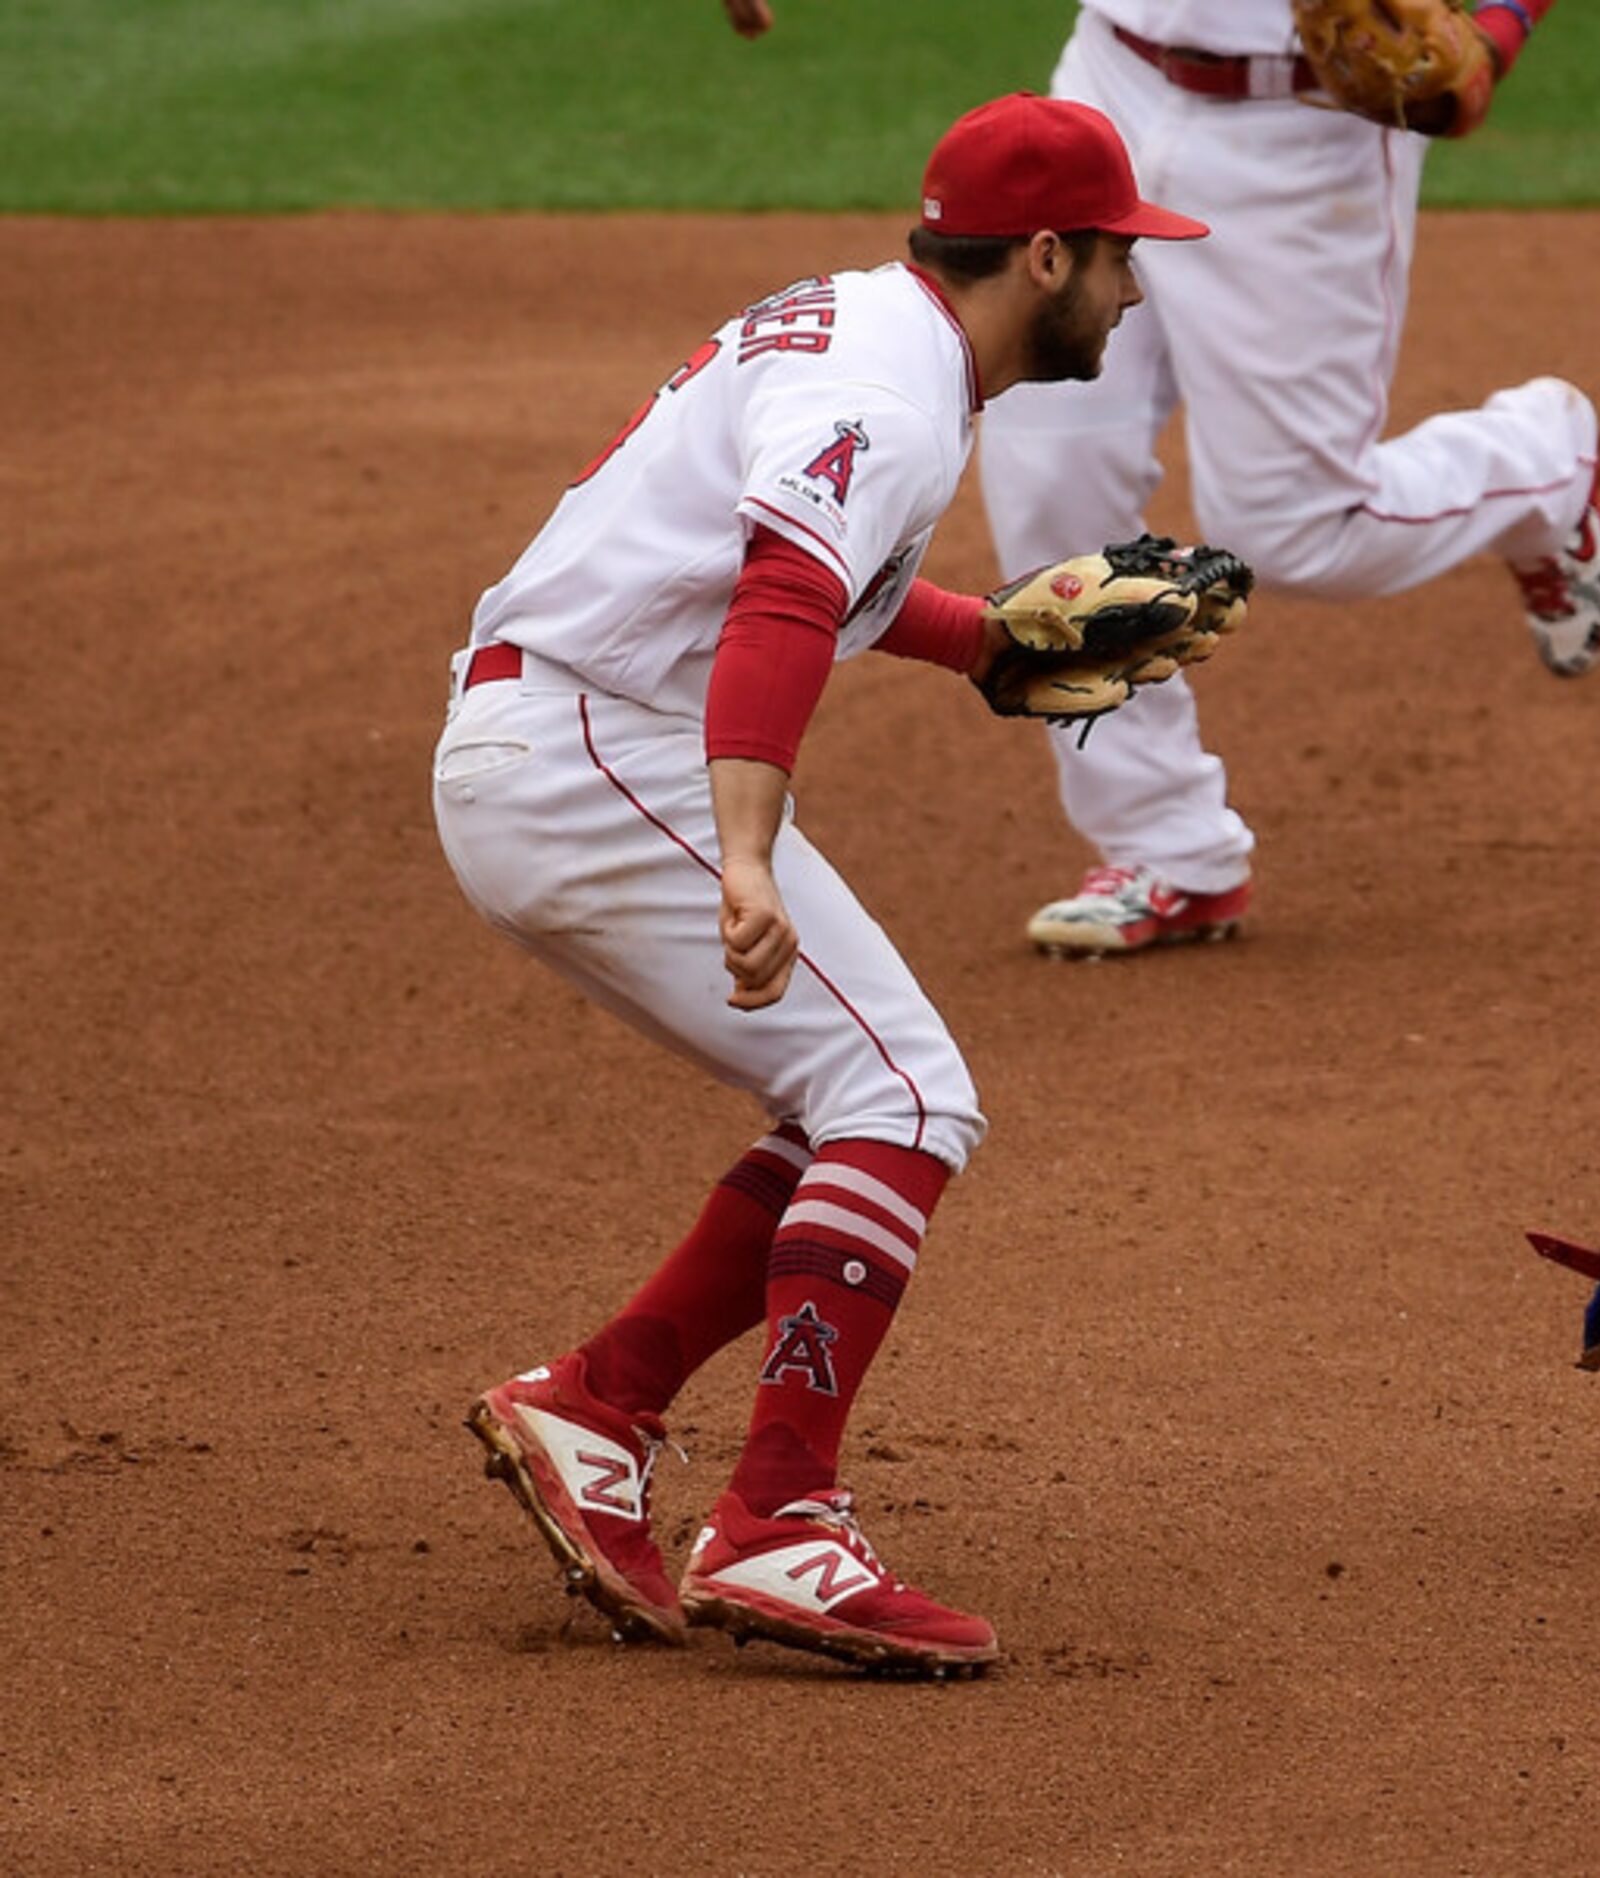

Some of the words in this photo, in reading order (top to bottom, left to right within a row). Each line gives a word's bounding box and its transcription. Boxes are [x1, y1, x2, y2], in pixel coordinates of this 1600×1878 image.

[802, 419, 870, 508] A
[760, 1301, 840, 1397] A
[784, 1550, 871, 1604] N
